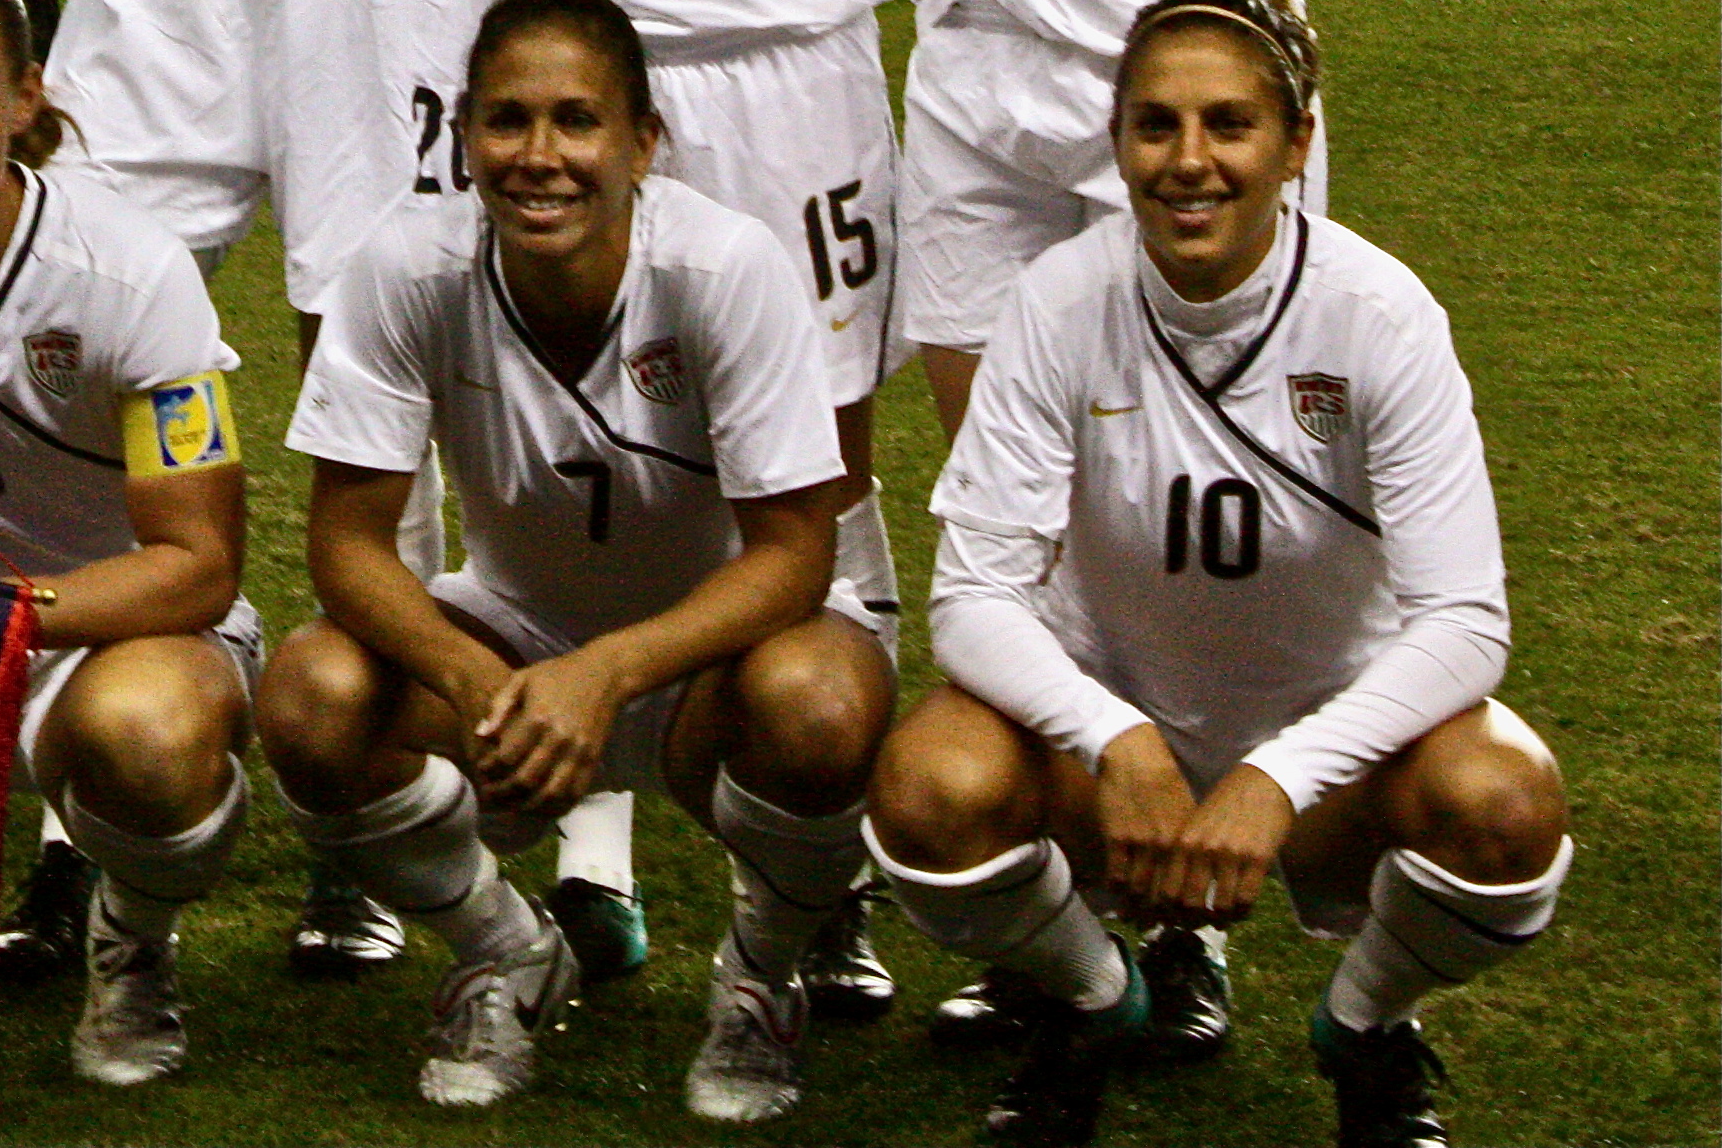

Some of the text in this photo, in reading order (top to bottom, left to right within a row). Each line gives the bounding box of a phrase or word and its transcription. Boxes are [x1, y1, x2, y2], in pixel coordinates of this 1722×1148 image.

[804, 180, 878, 301] 15
[554, 460, 611, 542] 7
[1165, 474, 1261, 579] 10
